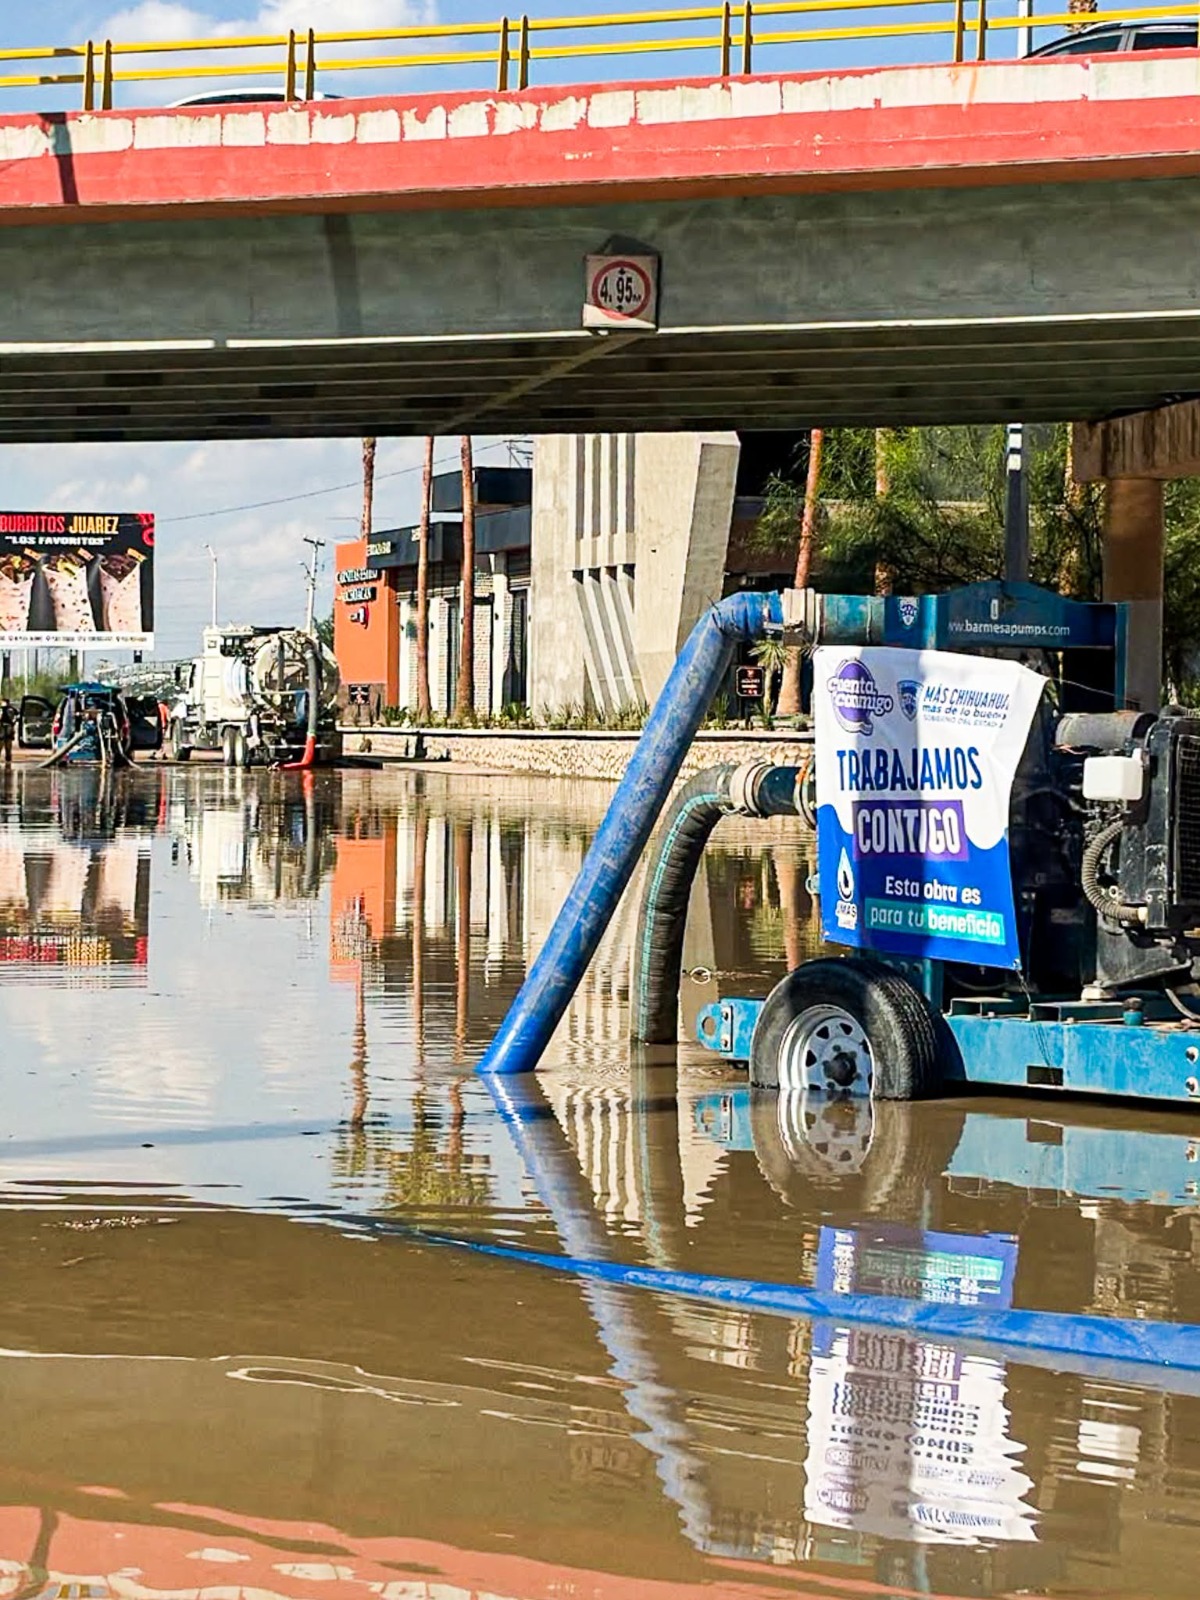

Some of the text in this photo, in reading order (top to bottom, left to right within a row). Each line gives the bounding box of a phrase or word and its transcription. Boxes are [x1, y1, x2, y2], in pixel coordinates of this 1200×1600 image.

[0, 514, 119, 534] BURRITOS JUAREZ
[945, 705, 958, 716] de
[960, 707, 971, 717] lo
[836, 746, 983, 791] TRABAJAMOS
[857, 807, 961, 854] CONTIGO
[885, 875, 982, 906] Esta obra es
[870, 907, 903, 927] para
[908, 908, 924, 927] tu
[927, 908, 1001, 938] beneficio
